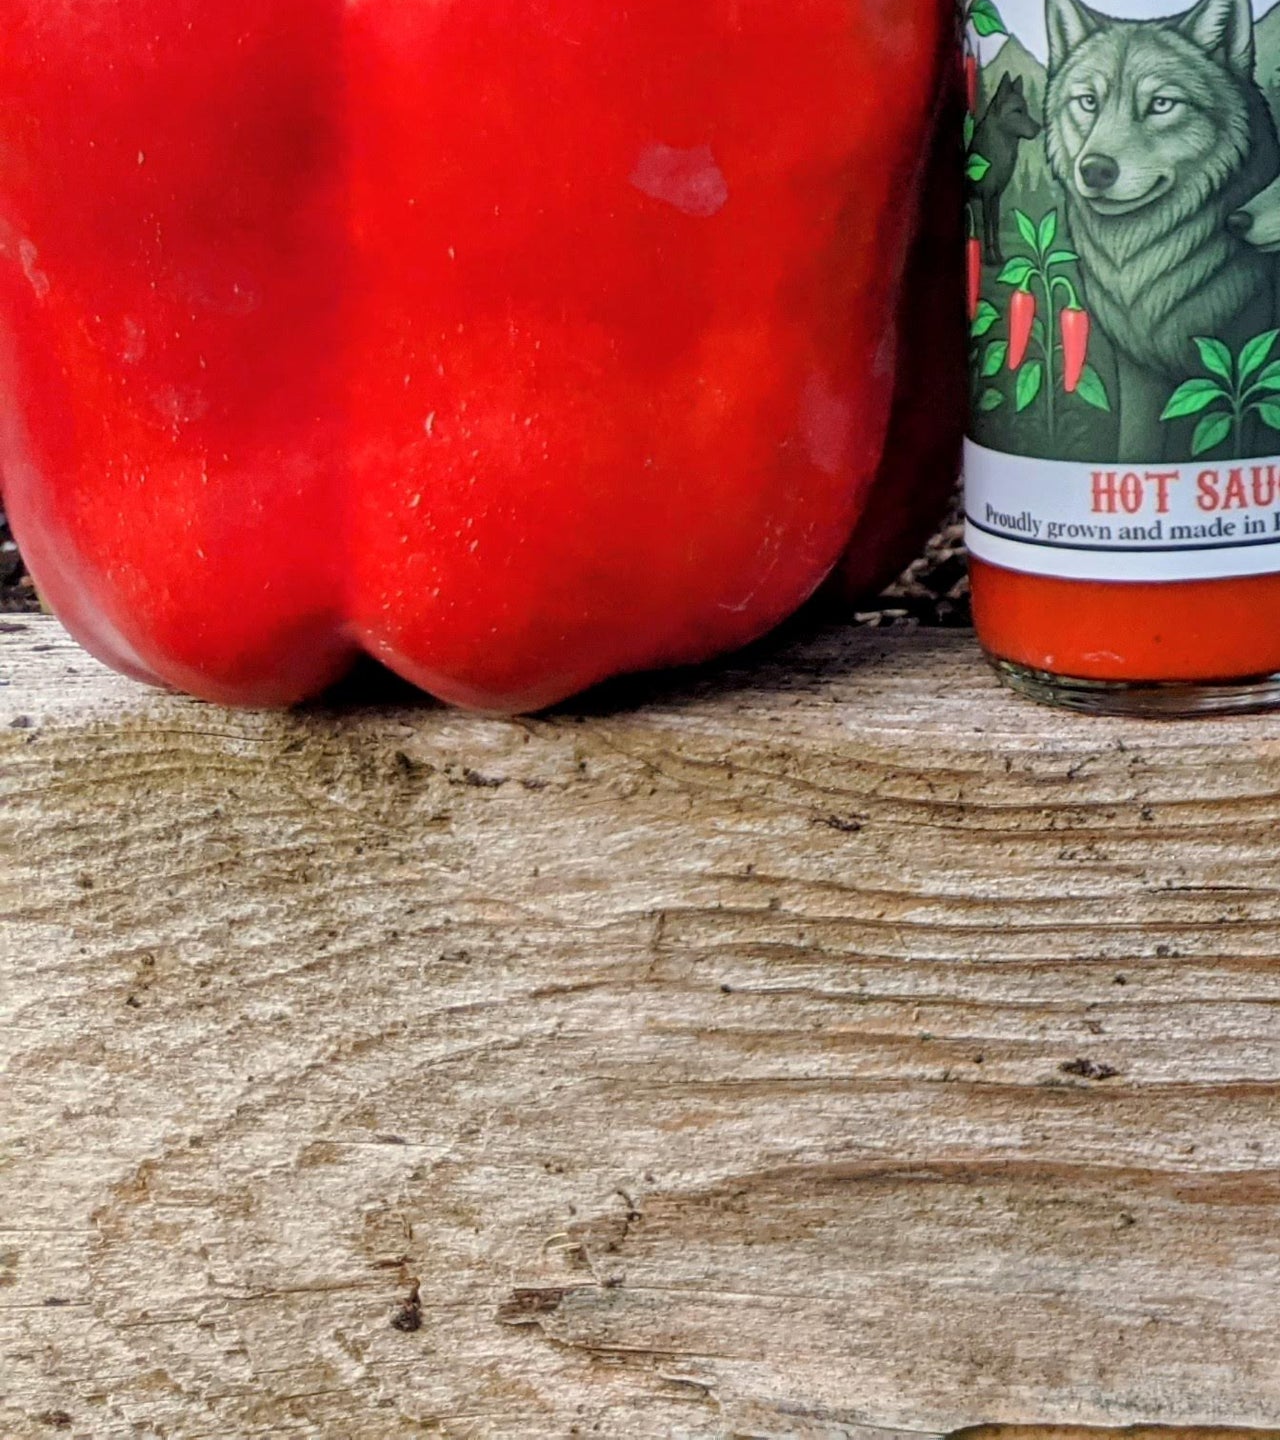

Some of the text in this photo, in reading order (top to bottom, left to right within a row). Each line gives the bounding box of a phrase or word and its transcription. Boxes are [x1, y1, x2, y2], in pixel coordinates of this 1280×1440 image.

[1091, 469, 1180, 514] HOT
[985, 503, 1042, 537] Proudly
[1047, 517, 1112, 541] grown
[1118, 520, 1162, 540] and
[1169, 518, 1236, 540] made
[1244, 513, 1266, 534] in
